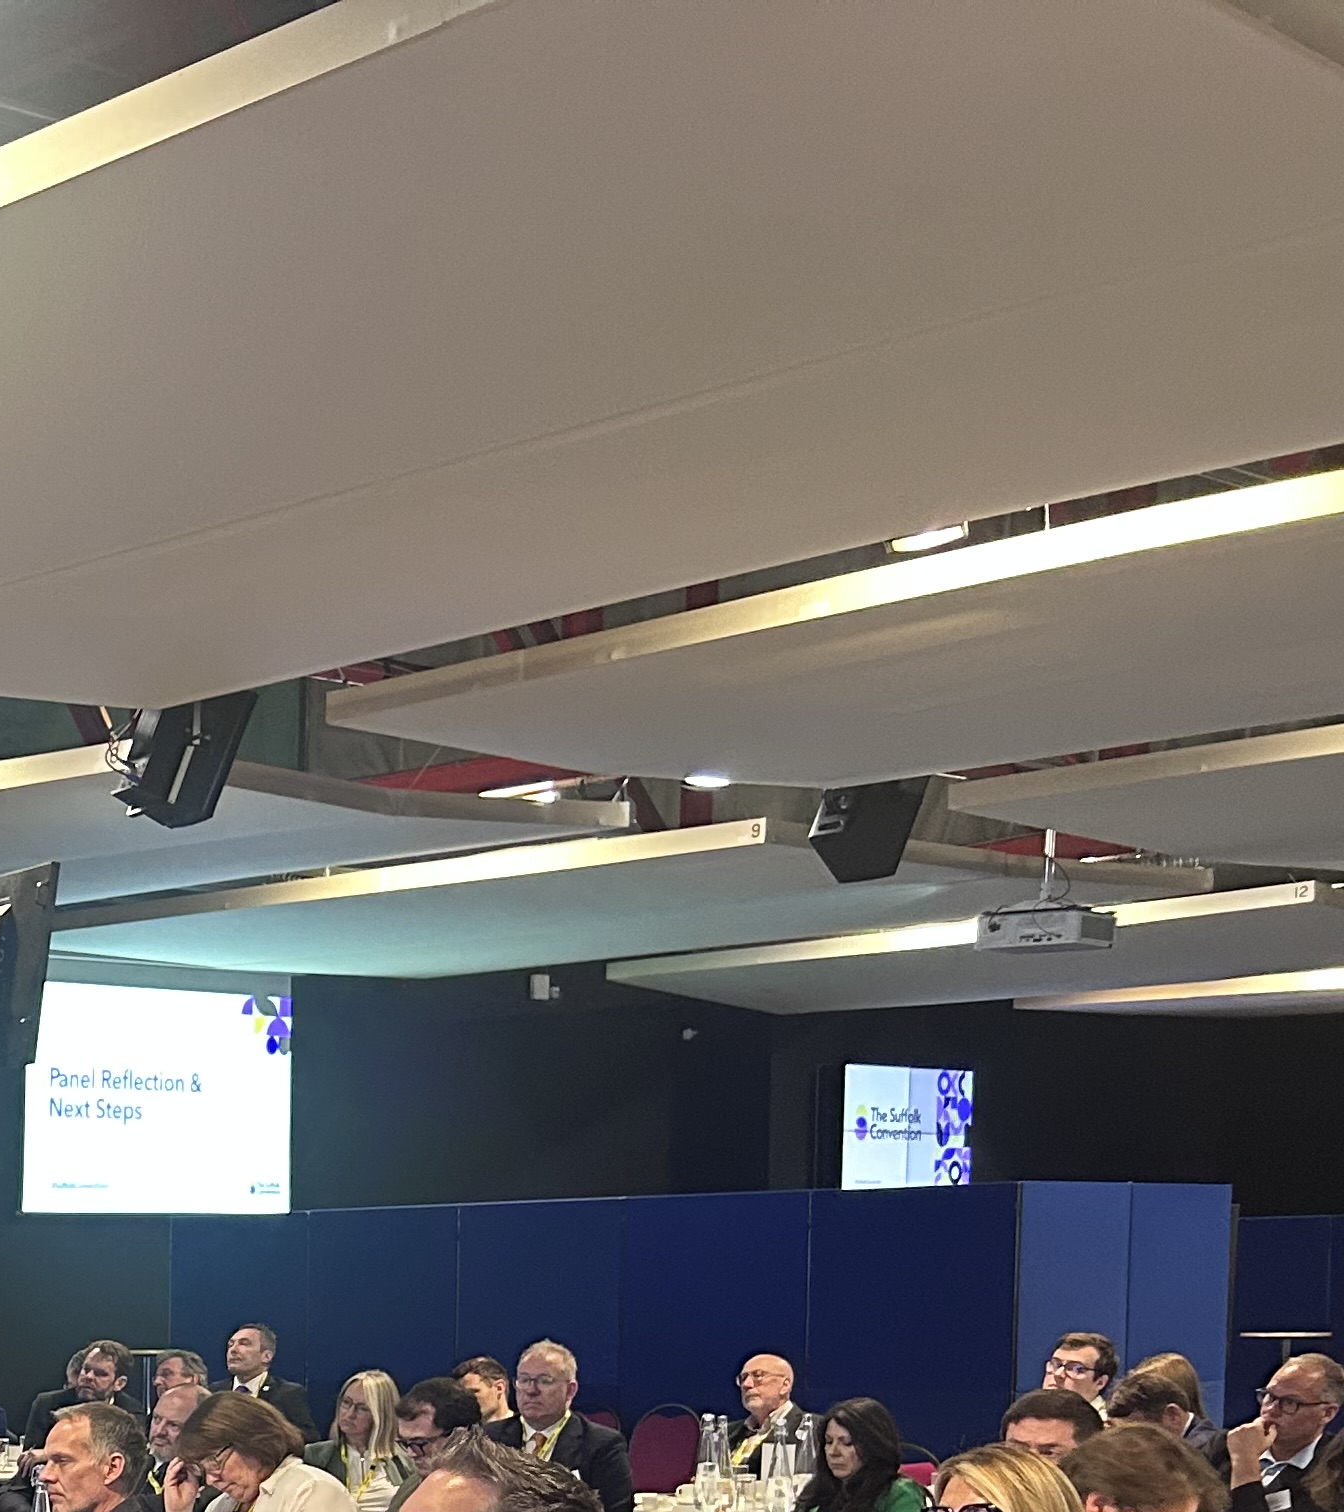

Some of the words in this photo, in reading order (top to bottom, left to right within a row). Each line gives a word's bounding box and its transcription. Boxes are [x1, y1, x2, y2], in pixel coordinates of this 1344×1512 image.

[50, 1067, 95, 1089] Panel
[102, 1068, 185, 1092] Reflection
[190, 1072, 202, 1093] &
[49, 1097, 90, 1119] Next
[96, 1098, 142, 1126] Steps
[871, 1106, 888, 1123] The
[889, 1107, 921, 1125] Suffolk
[870, 1123, 922, 1142] Convention
